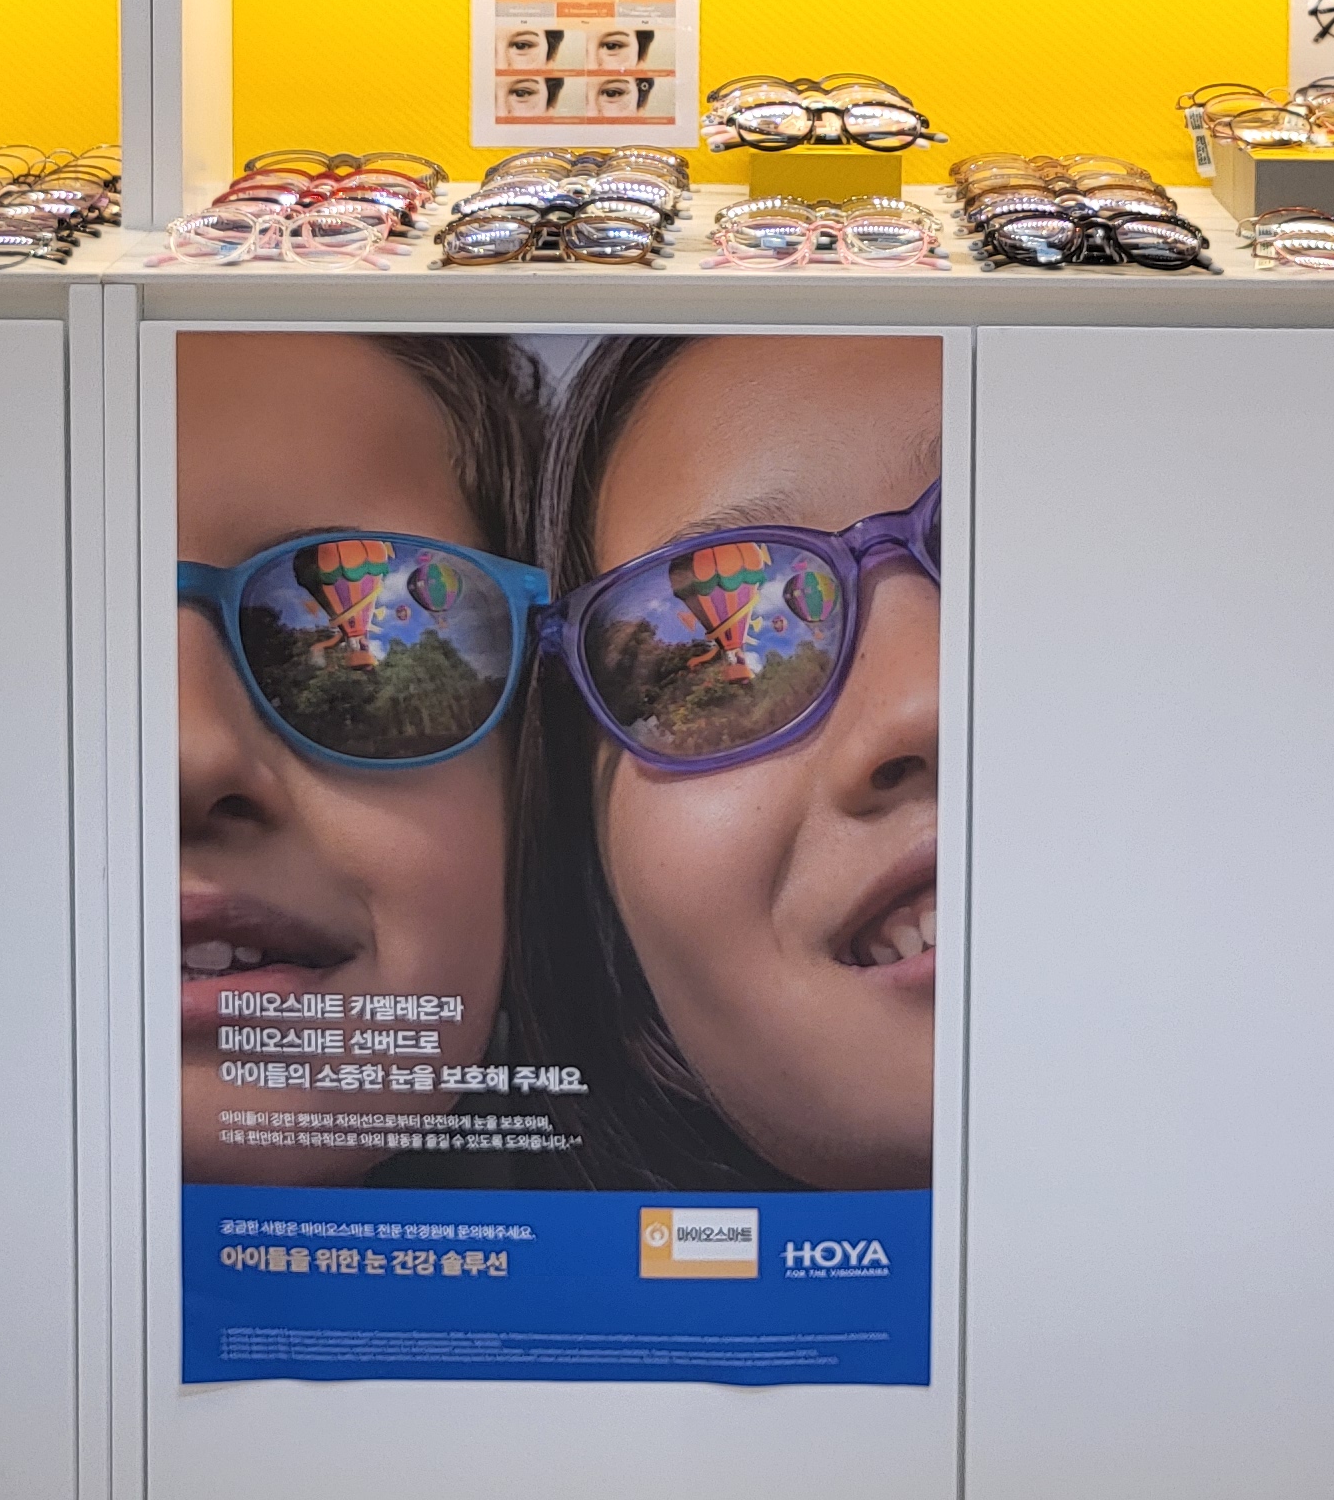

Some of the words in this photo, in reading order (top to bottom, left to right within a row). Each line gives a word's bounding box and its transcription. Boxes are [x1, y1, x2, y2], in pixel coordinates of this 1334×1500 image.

[218, 990, 344, 1020] 마이오스마트
[349, 994, 464, 1022] 카멜레온과
[218, 1025, 345, 1055] 마이오스마트
[349, 1028, 442, 1056] 선버드로
[221, 1061, 310, 1089] 아이들의
[315, 1063, 384, 1091] 소중한
[389, 1064, 434, 1091] 눈을
[440, 1065, 509, 1094] 보호해
[512, 1066, 589, 1095] 주세요.
[220, 1110, 268, 1126] 아이들이
[270, 1111, 295, 1127] 강한
[297, 1112, 333, 1127] 햇빛과
[334, 1112, 420, 1128] 자외선으로부터
[423, 1114, 471, 1130] 안전하게
[474, 1115, 498, 1130] 눈을
[360, 1132, 384, 1147] 야외
[451, 1134, 464, 1148] 수
[467, 1134, 503, 1149] 있도록
[220, 1219, 259, 1235] 궁금한
[261, 1220, 297, 1236] 사항은
[299, 1222, 375, 1237] 마이오스마트
[376, 1223, 402, 1238] 전문
[404, 1224, 455, 1239] 안경원에
[457, 1224, 536, 1240] 문의해주세요.
[677, 1226, 753, 1243] 마이오스마트
[221, 1245, 310, 1273] 아이들을
[315, 1247, 359, 1274] 위한
[364, 1249, 387, 1275] 눈
[391, 1250, 436, 1275] 건강
[440, 1250, 508, 1277] 솔루션
[781, 1240, 890, 1266] HOYA
[785, 1268, 806, 1278] FOR
[809, 1268, 828, 1278] THE
[830, 1268, 889, 1278] VISIONARIES
